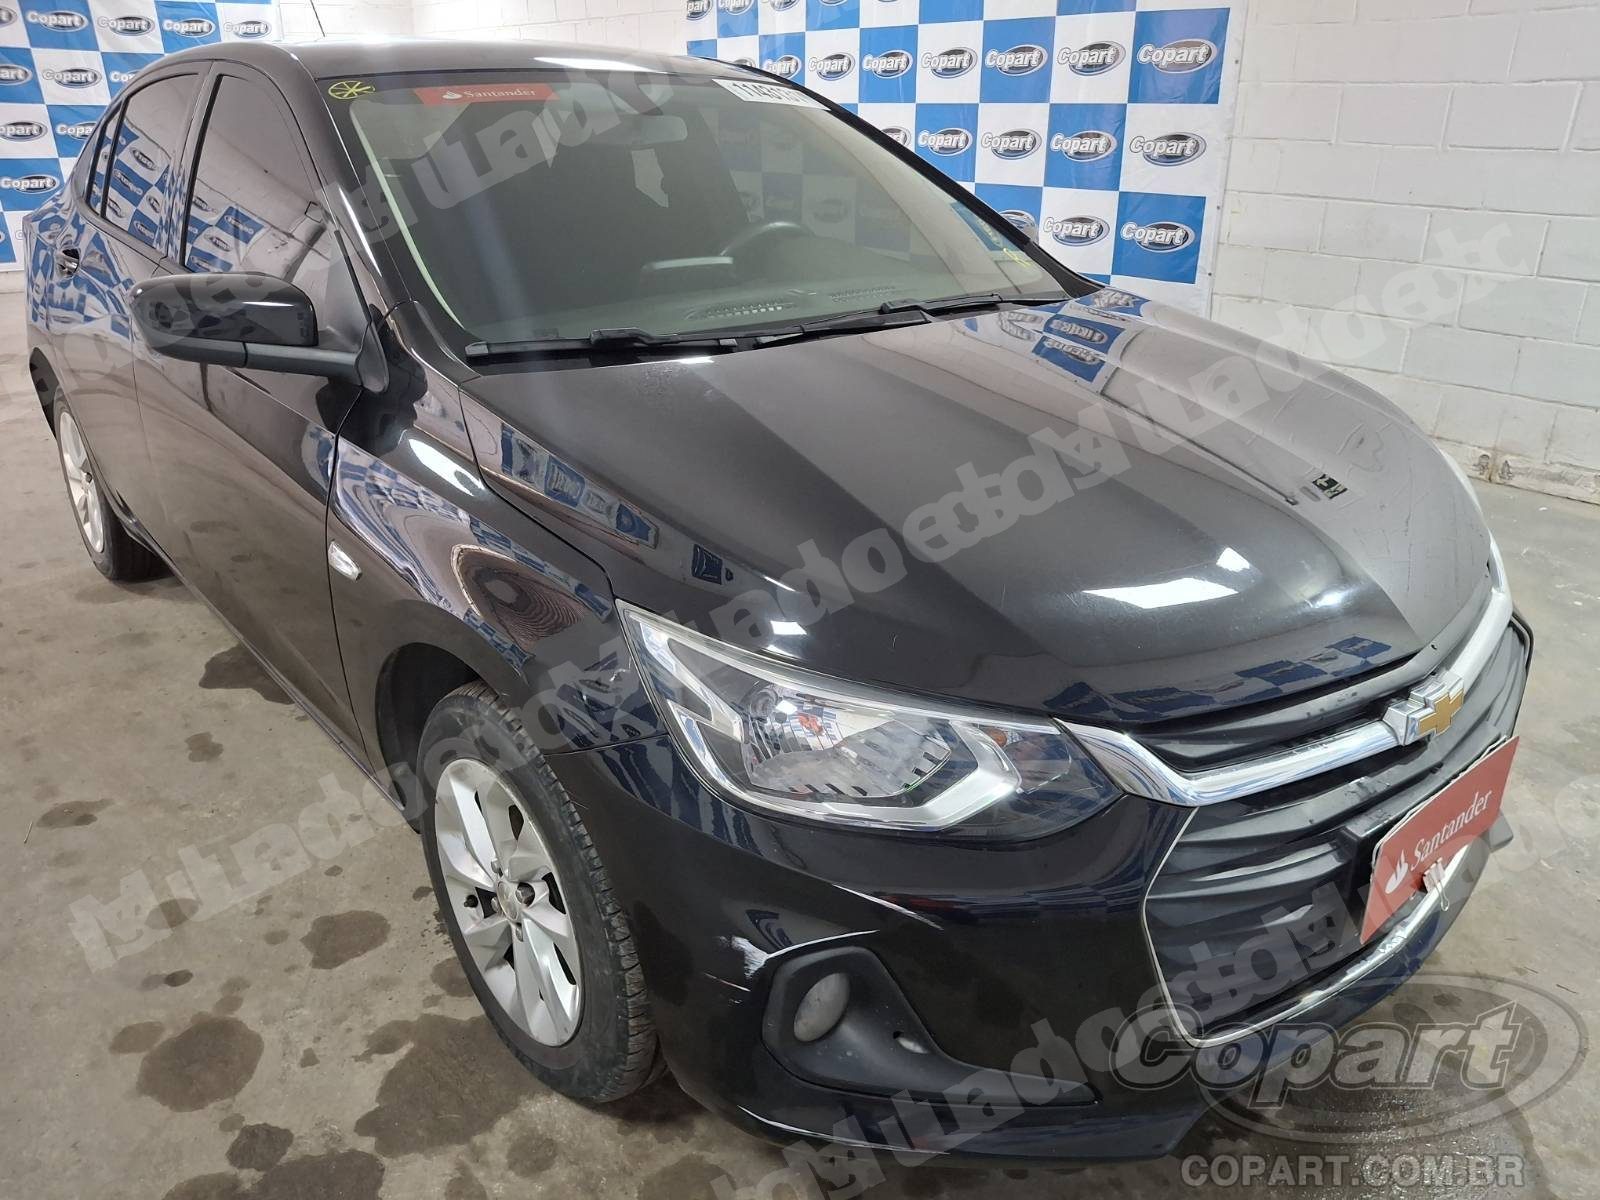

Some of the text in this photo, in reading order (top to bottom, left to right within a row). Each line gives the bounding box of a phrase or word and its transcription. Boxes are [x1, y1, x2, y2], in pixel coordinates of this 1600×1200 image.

[27, 11, 82, 27] Copart
[98, 16, 148, 31] Copart
[163, 20, 210, 35] Copart
[224, 22, 268, 36] Copart
[808, 54, 849, 76] Copart
[862, 52, 908, 74] Copart
[921, 50, 971, 73] Copart
[985, 47, 1040, 70] Copart
[1057, 46, 1115, 70] Copart
[1137, 43, 1210, 70] Copart
[42, 69, 93, 84] Copart
[463, 88, 537, 98] Santander
[0, 123, 41, 138] opart
[56, 124, 94, 139] Copa
[918, 130, 967, 151] Copart
[981, 132, 1034, 153] Copart
[1052, 132, 1107, 156] Copart
[1129, 135, 1196, 161] Copart
[0, 177, 53, 191] Copart
[1043, 217, 1100, 239] Copart
[1121, 221, 1186, 246] Copart
[1410, 790, 1493, 872] Santander
